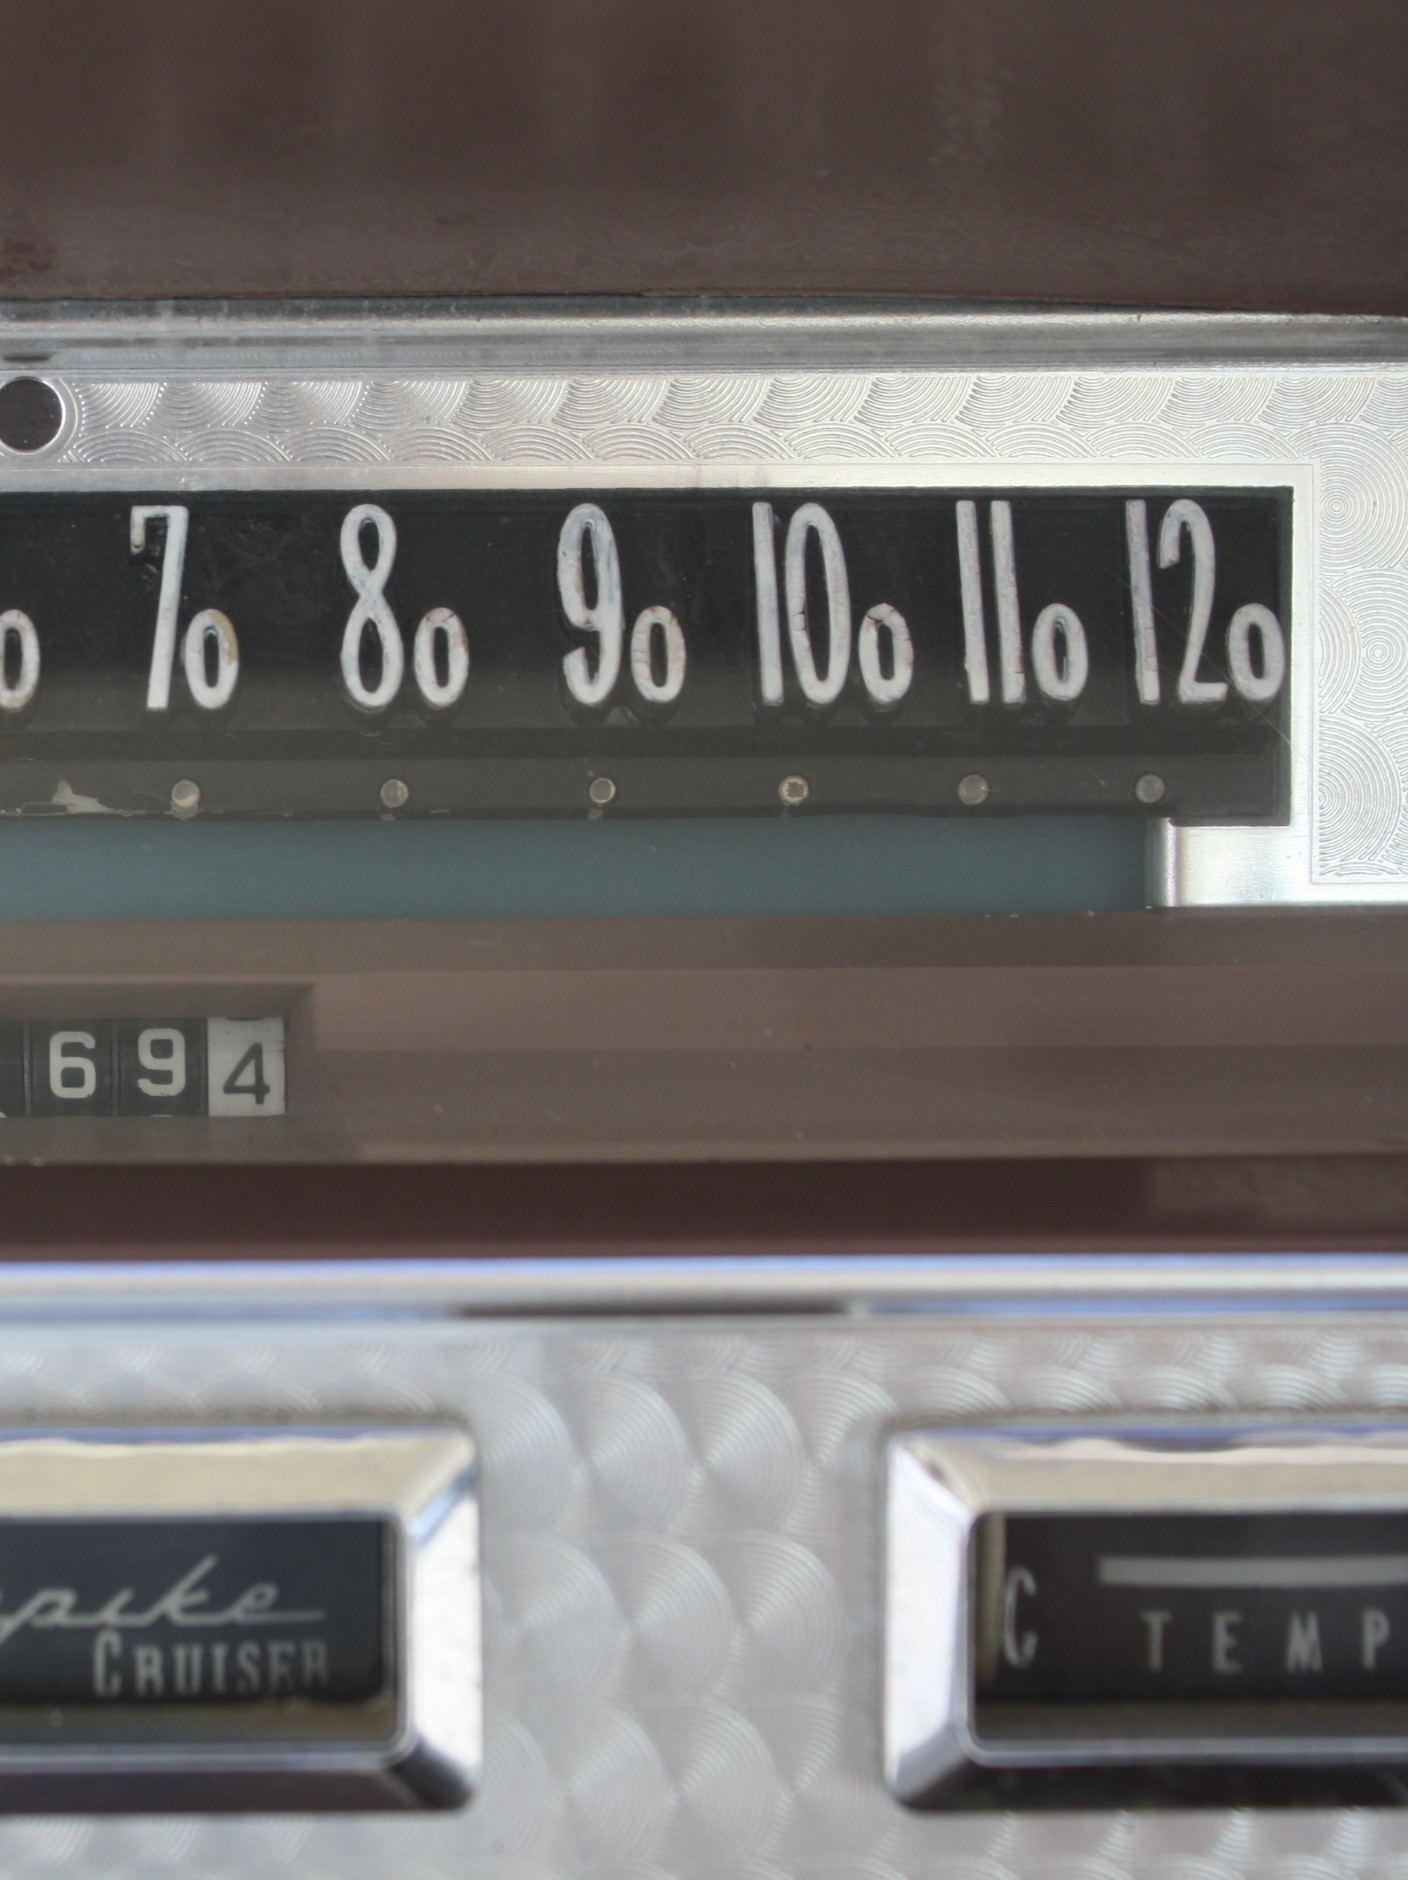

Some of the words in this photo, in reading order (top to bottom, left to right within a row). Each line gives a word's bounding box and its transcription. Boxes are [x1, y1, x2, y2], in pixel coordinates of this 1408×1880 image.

[129, 504, 240, 710] 70
[339, 503, 470, 709] 80
[556, 502, 687, 706] 90
[751, 501, 915, 708] 100
[955, 499, 1090, 706] 110
[1124, 498, 1286, 706] 120
[1002, 1565, 1038, 1670] C
[1139, 1607, 1391, 1674] TEMP
[93, 1629, 331, 1699] CRUISER
